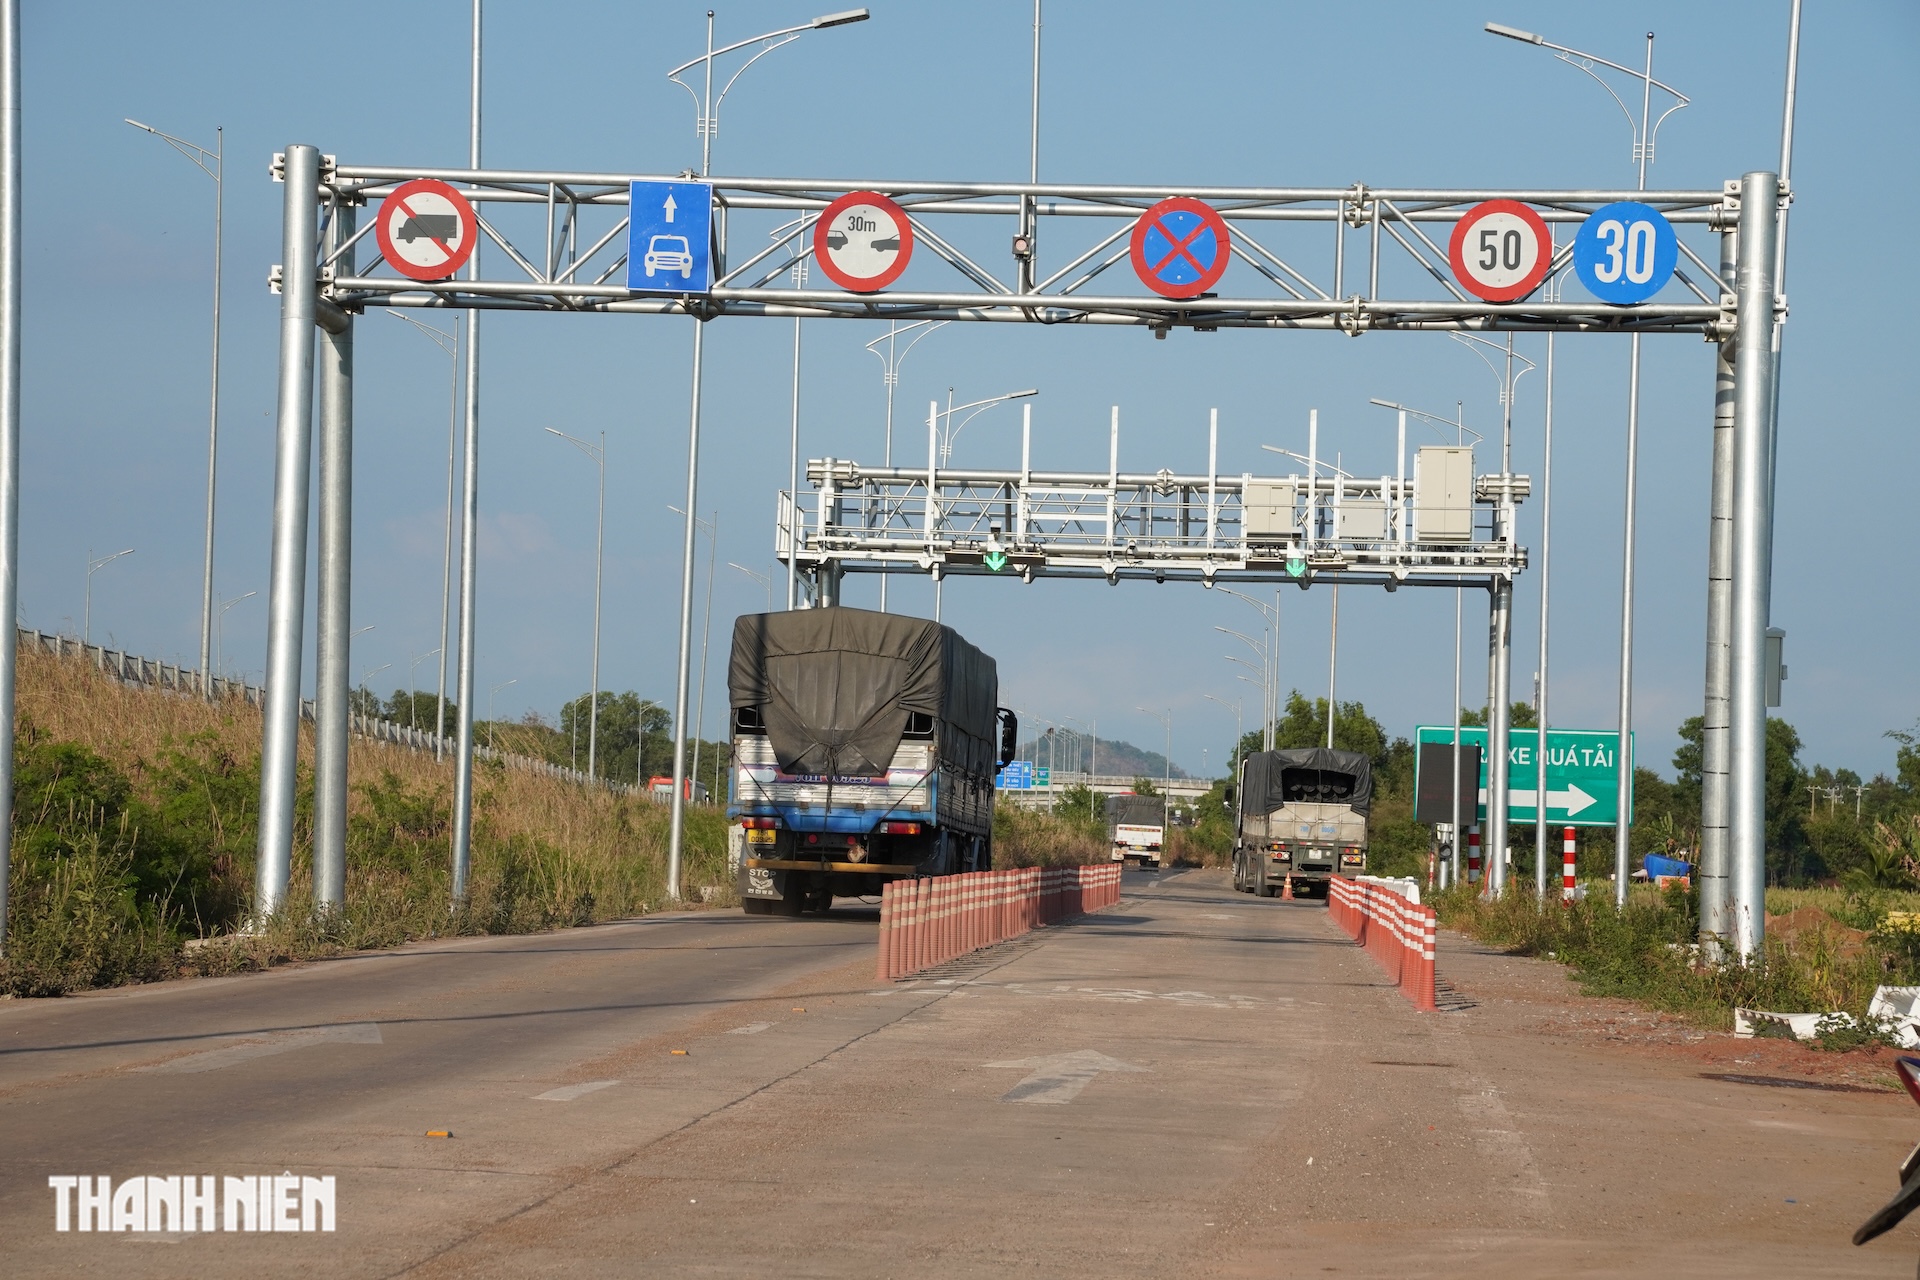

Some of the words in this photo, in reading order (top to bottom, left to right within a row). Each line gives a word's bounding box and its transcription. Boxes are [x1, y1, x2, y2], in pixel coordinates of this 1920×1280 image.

[848, 216, 876, 232] 30m
[1479, 230, 1521, 271] 50
[1594, 219, 1656, 284] 30
[1508, 747, 1531, 765] XE
[1581, 743, 1613, 767] TẢI
[749, 868, 777, 878] STOP
